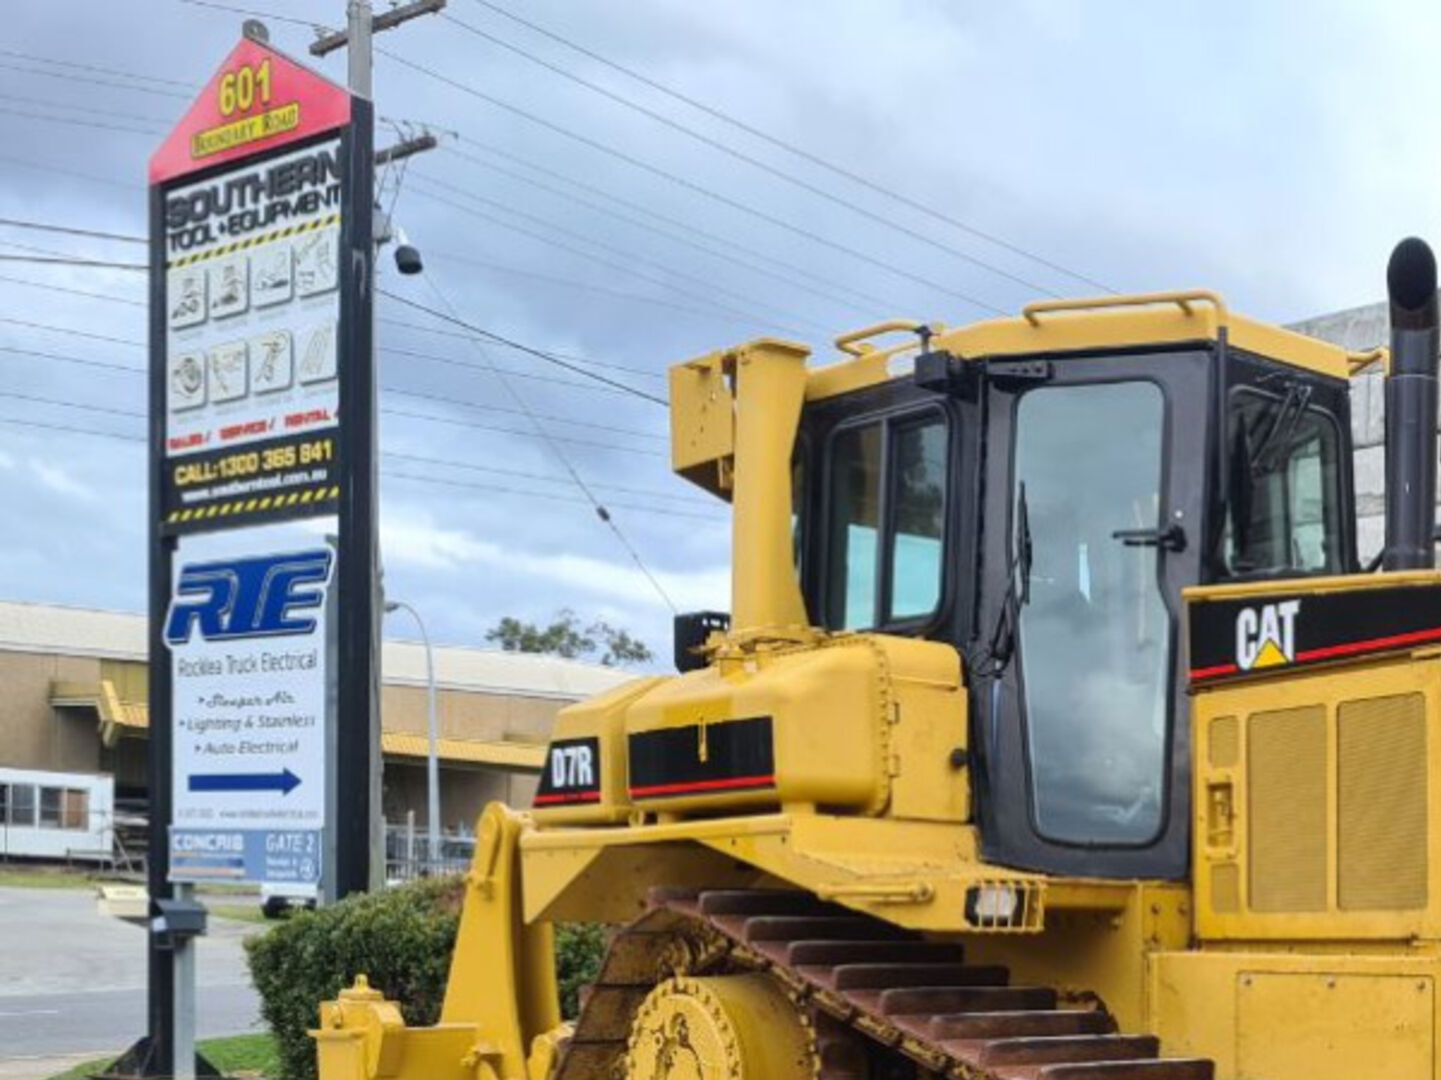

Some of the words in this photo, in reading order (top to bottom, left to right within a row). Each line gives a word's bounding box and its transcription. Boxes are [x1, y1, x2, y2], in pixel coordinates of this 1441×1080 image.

[219, 57, 272, 117] 601
[167, 147, 341, 229] SOUTHERN
[300, 440, 333, 464] 841
[166, 550, 332, 643] RTE
[1236, 599, 1301, 671] CAT
[226, 654, 257, 675] Truck
[261, 649, 318, 672] Electrical
[203, 743, 236, 755] Auto
[239, 739, 299, 754] Electrical
[551, 745, 594, 788] D7R
[266, 833, 301, 851] GATE
